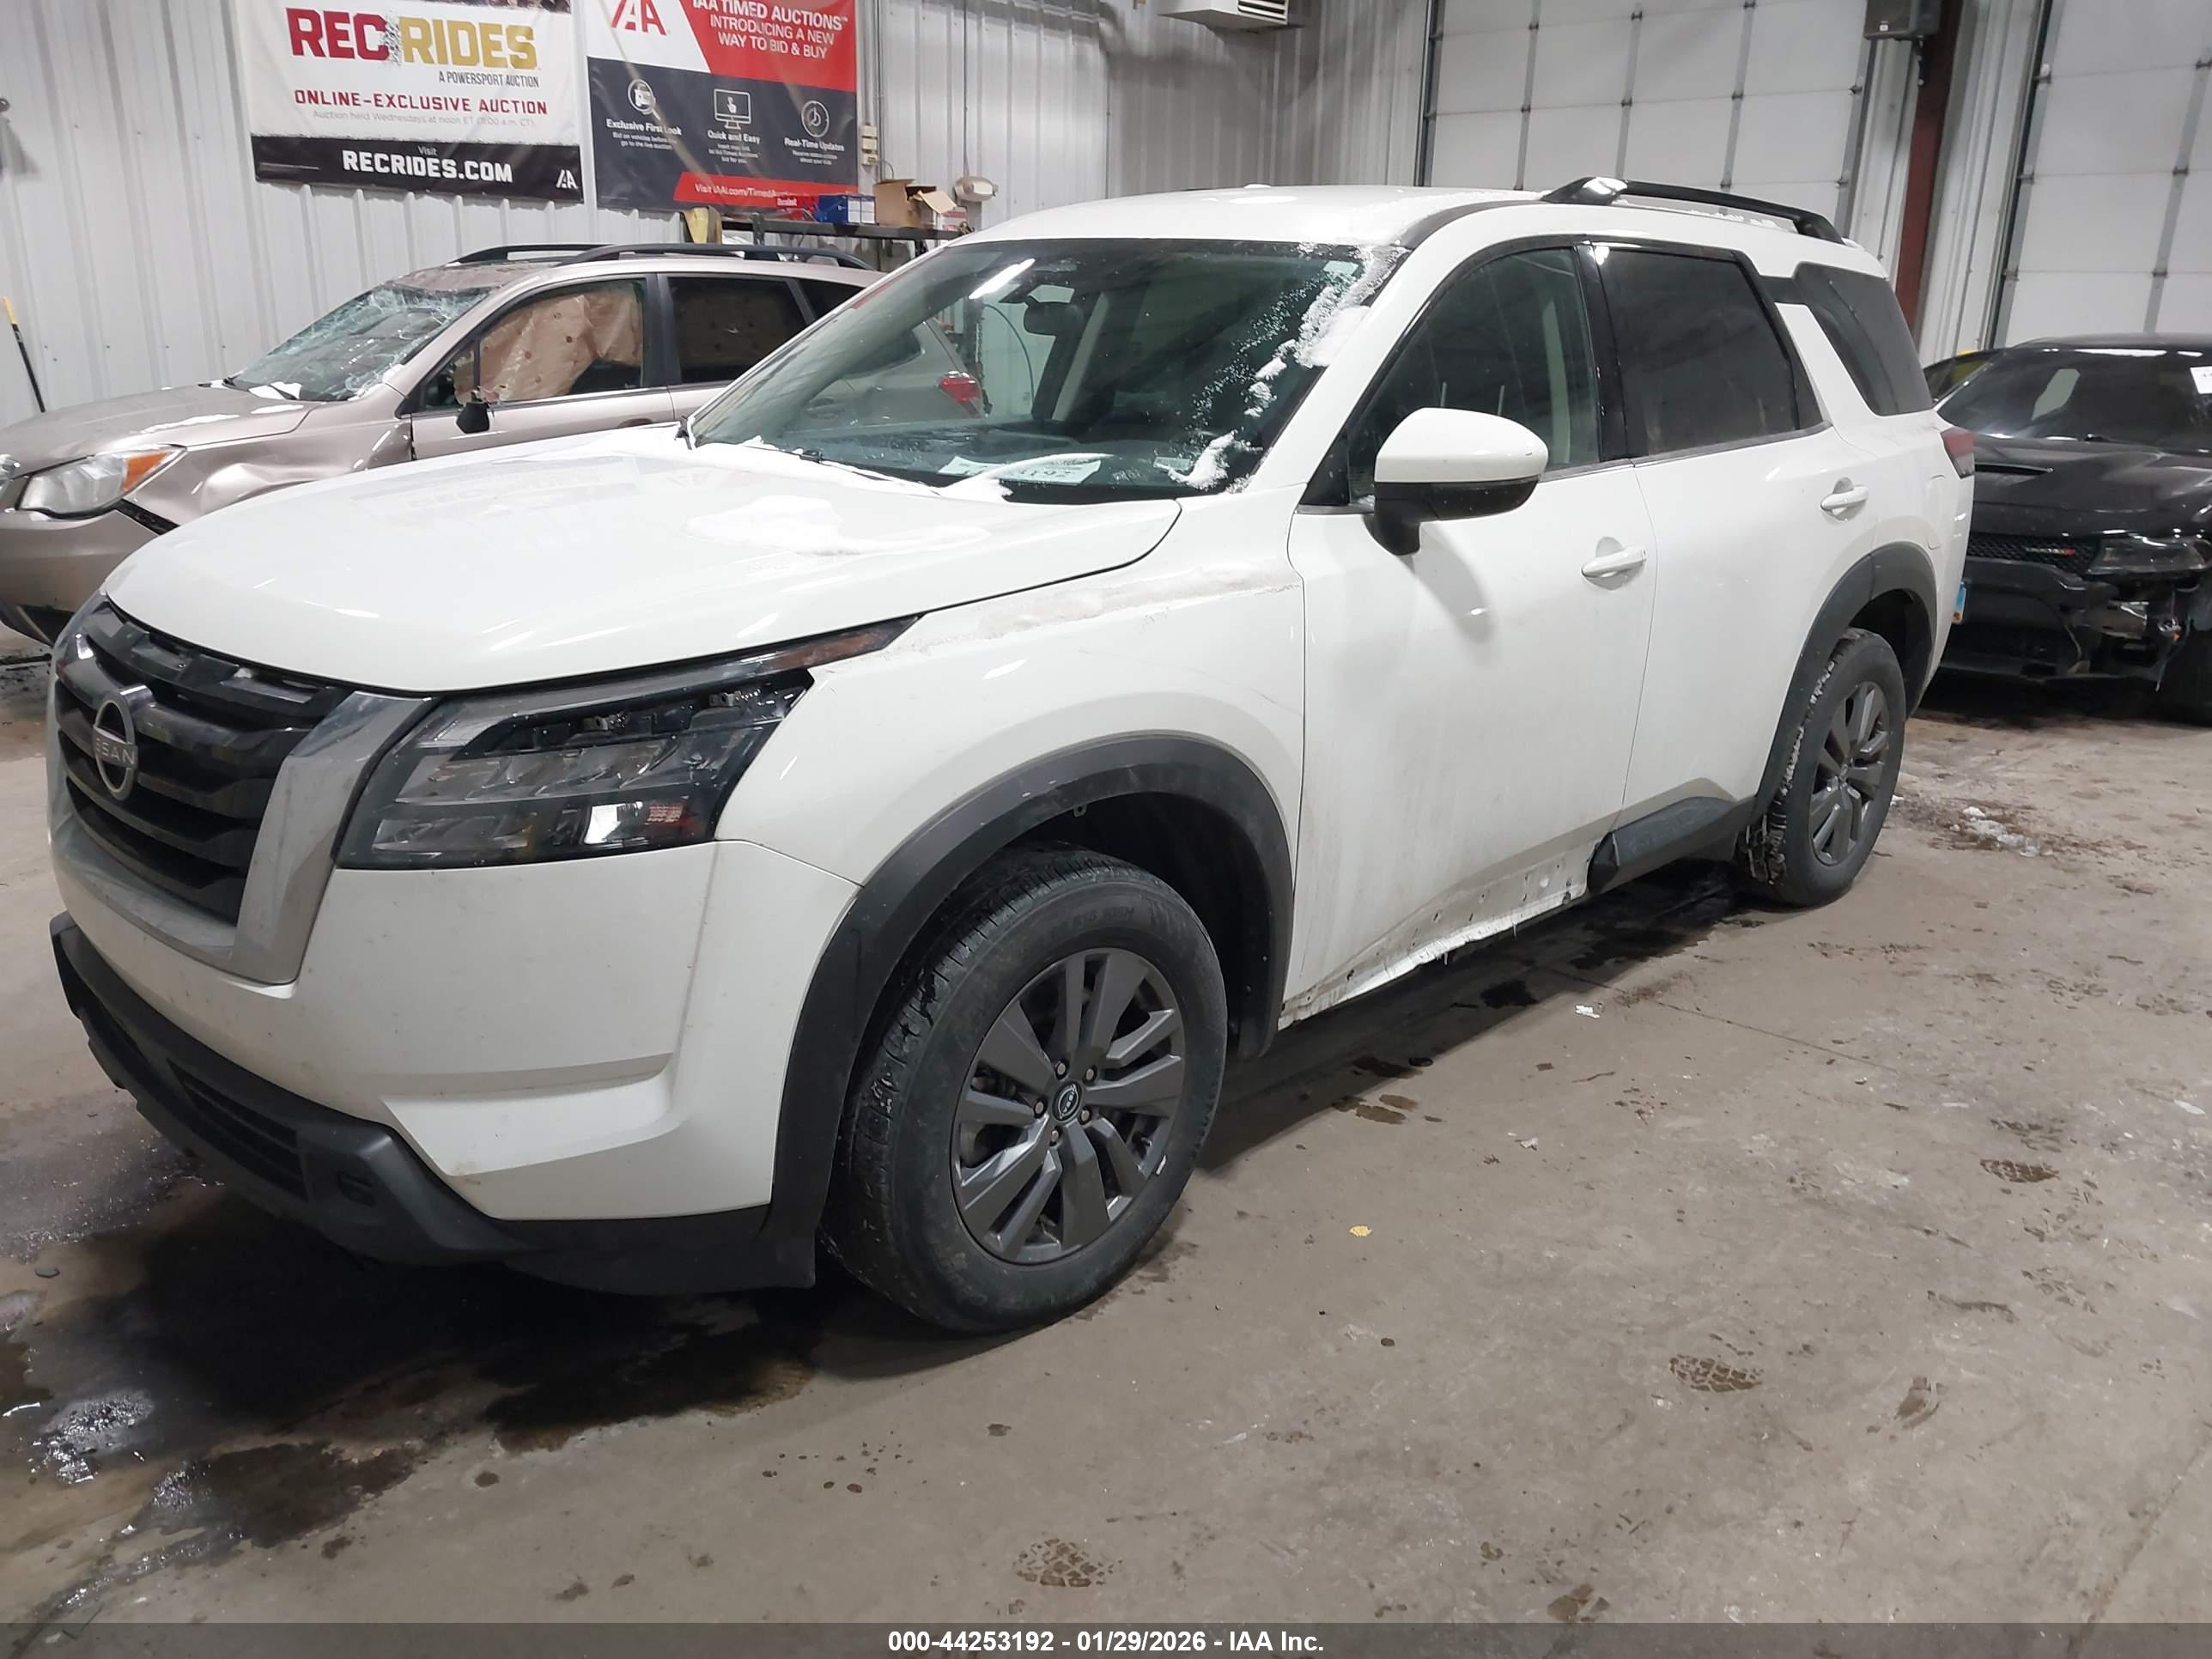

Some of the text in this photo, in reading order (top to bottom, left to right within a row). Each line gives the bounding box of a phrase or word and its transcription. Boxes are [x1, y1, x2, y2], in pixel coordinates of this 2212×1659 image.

[693, 0, 842, 31] IAA TIMED AUCTIONS
[286, 8, 538, 70] REC RIDES
[710, 15, 835, 46] INTRODUCING A NEW
[718, 32, 827, 59] WAY TO BID & BUY
[439, 70, 539, 88] A POWERSPORT AUCTION
[295, 89, 547, 114] ONLINE-EXCLUSIVE AUCTION
[313, 111, 348, 119] Auction
[372, 112, 428, 124] Wednesdays
[606, 118, 644, 131] Exclusive
[707, 130, 761, 145] Quick and Easy
[784, 137, 845, 153] Real-Time Updates
[417, 144, 437, 156] Visit
[342, 149, 513, 183] RECRIDES.COM
[695, 183, 711, 193] Visit
